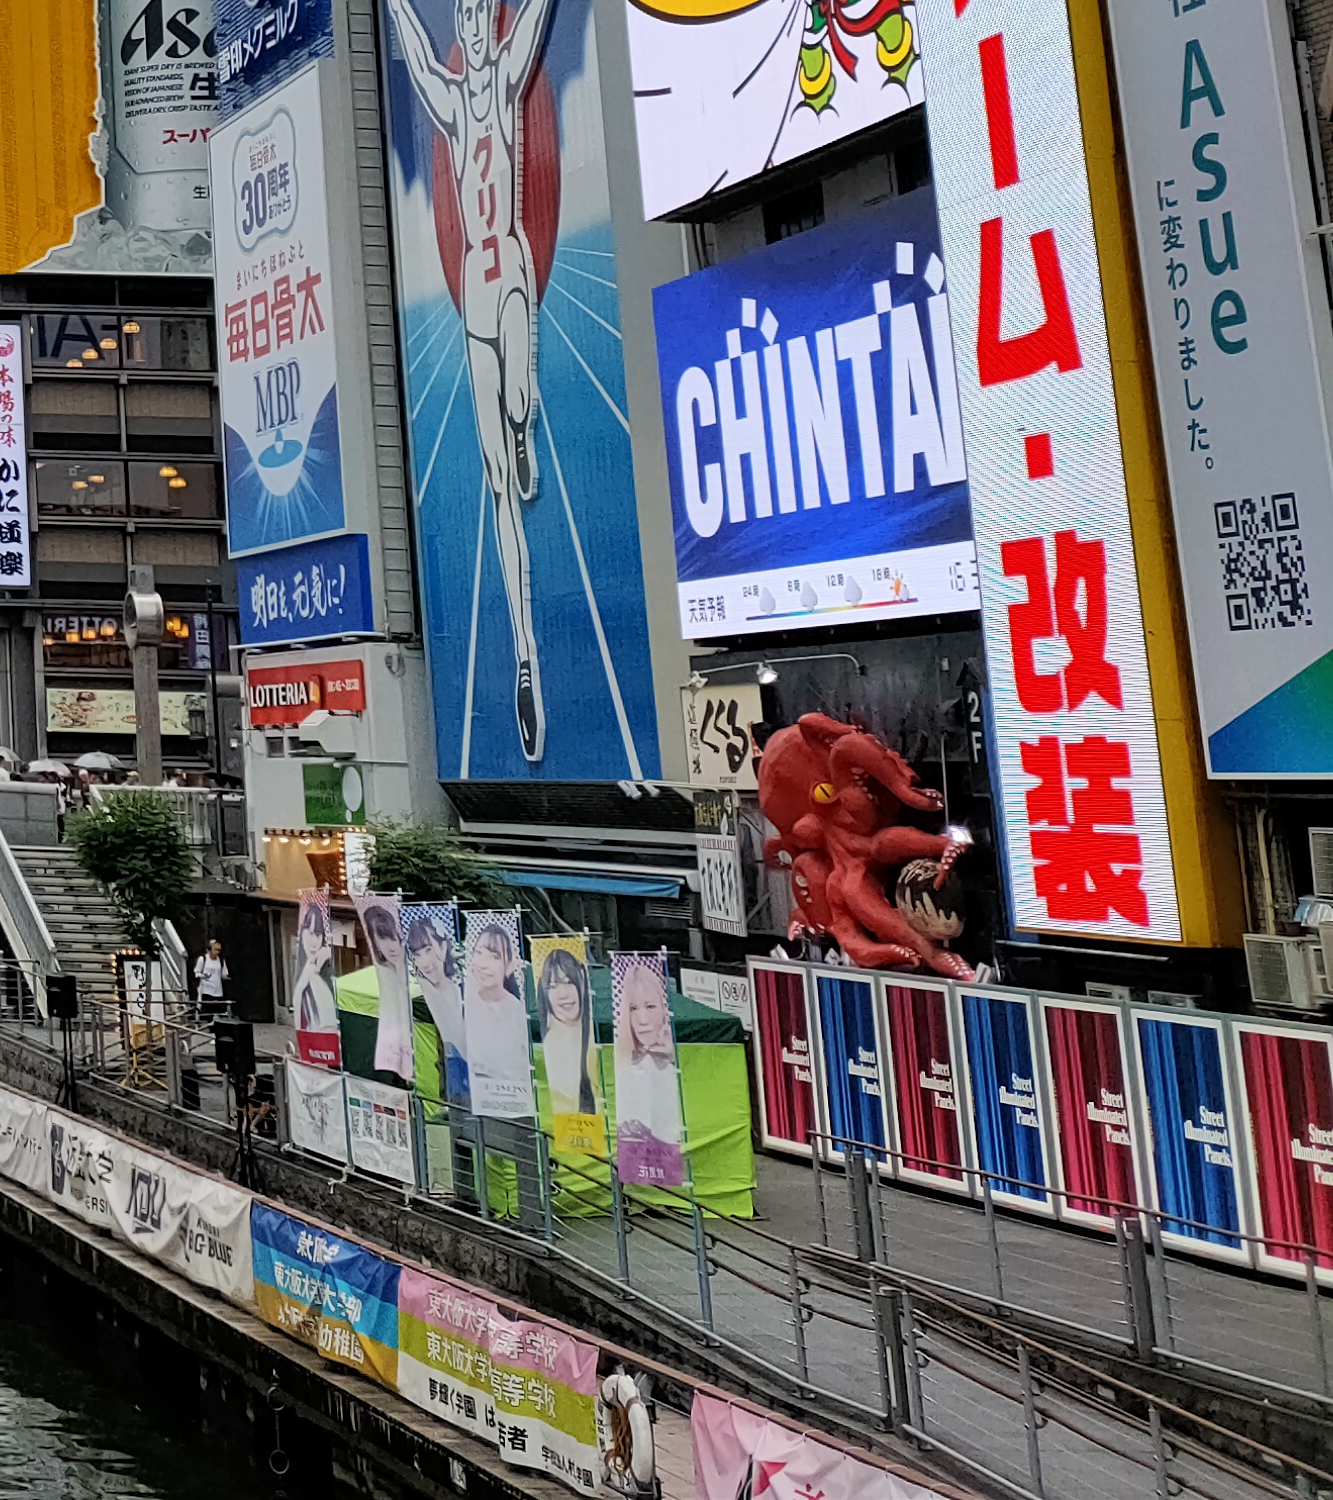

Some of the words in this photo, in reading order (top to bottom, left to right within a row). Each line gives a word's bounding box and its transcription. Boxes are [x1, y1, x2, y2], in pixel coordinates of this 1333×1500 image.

[241, 172, 269, 236] 30
[472, 121, 502, 284] グリコ
[1179, 38, 1247, 357] Asue
[235, 238, 306, 292] まいにちほねぶと
[224, 266, 326, 364] 毎日骨太
[1155, 178, 1215, 473] に変わりました。
[253, 358, 302, 434] MBP
[676, 248, 968, 540] CHINTAI
[250, 681, 309, 709] LOTTERIA
[1199, 1105, 1225, 1127] Street
